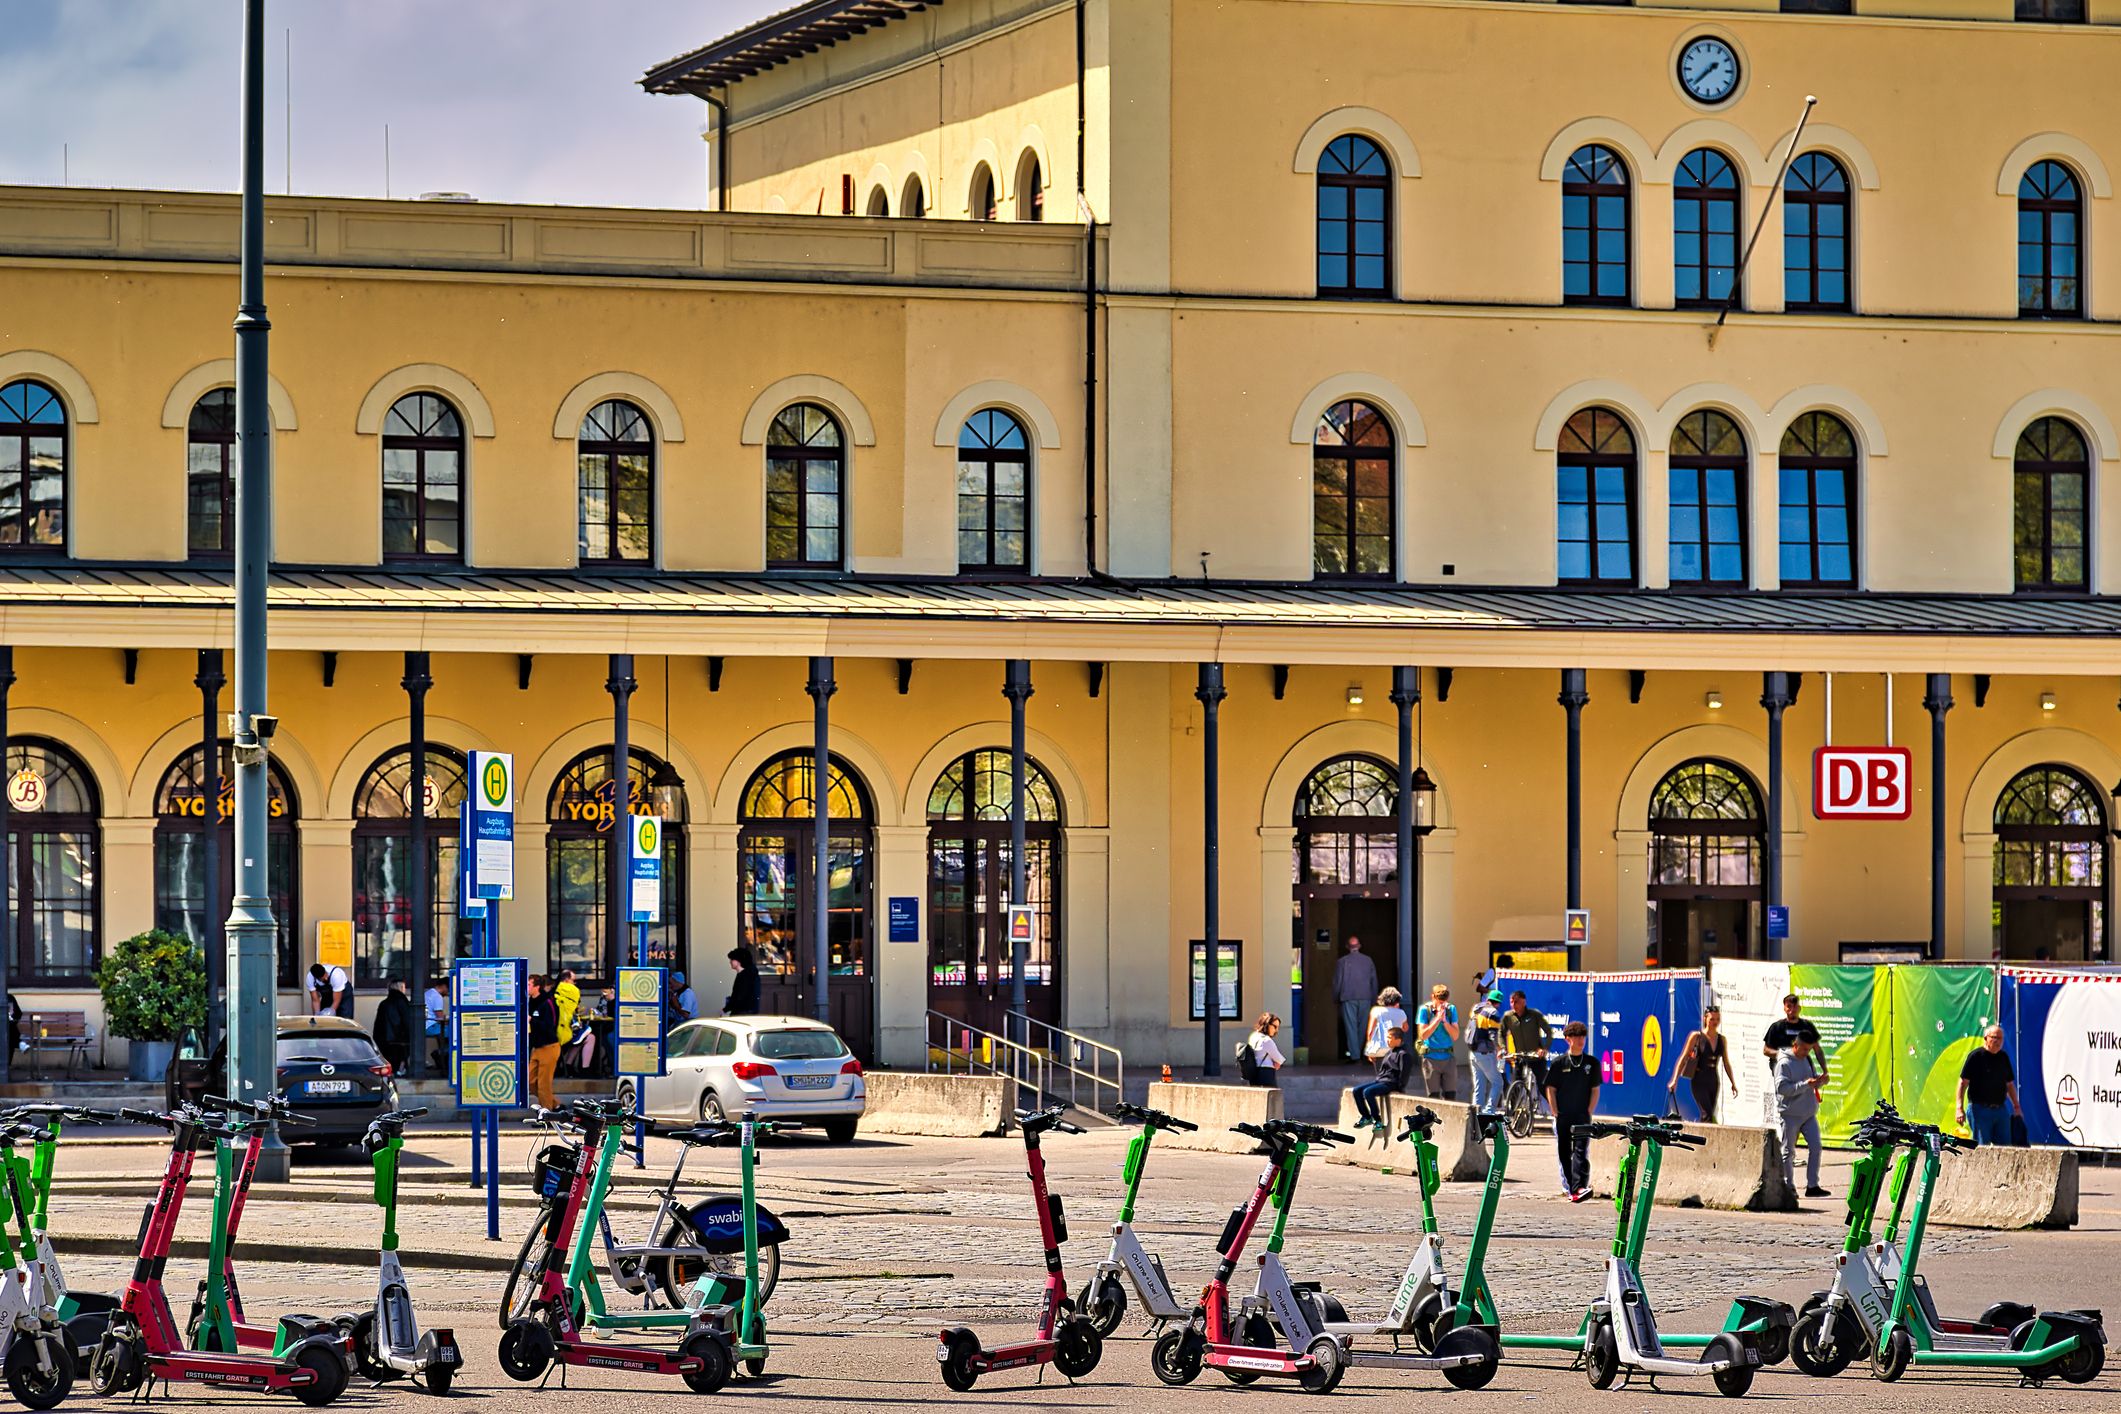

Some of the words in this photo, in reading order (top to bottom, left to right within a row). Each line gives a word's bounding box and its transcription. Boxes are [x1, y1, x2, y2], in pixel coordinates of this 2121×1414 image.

[490, 768, 502, 796] H
[1829, 758, 1900, 808] DB
[628, 950, 676, 960] OMA'S
[214, 1175, 222, 1198] Bolt
[1488, 1168, 1502, 1190] Bolt
[1641, 1167, 1653, 1190] Bolt
[1916, 1181, 1928, 1203] Bolt
[708, 1210, 743, 1224] swabi
[1394, 1272, 1418, 1311] Lime
[185, 1371, 204, 1379] ERSTE
[623, 1361, 644, 1369] GRATIS
